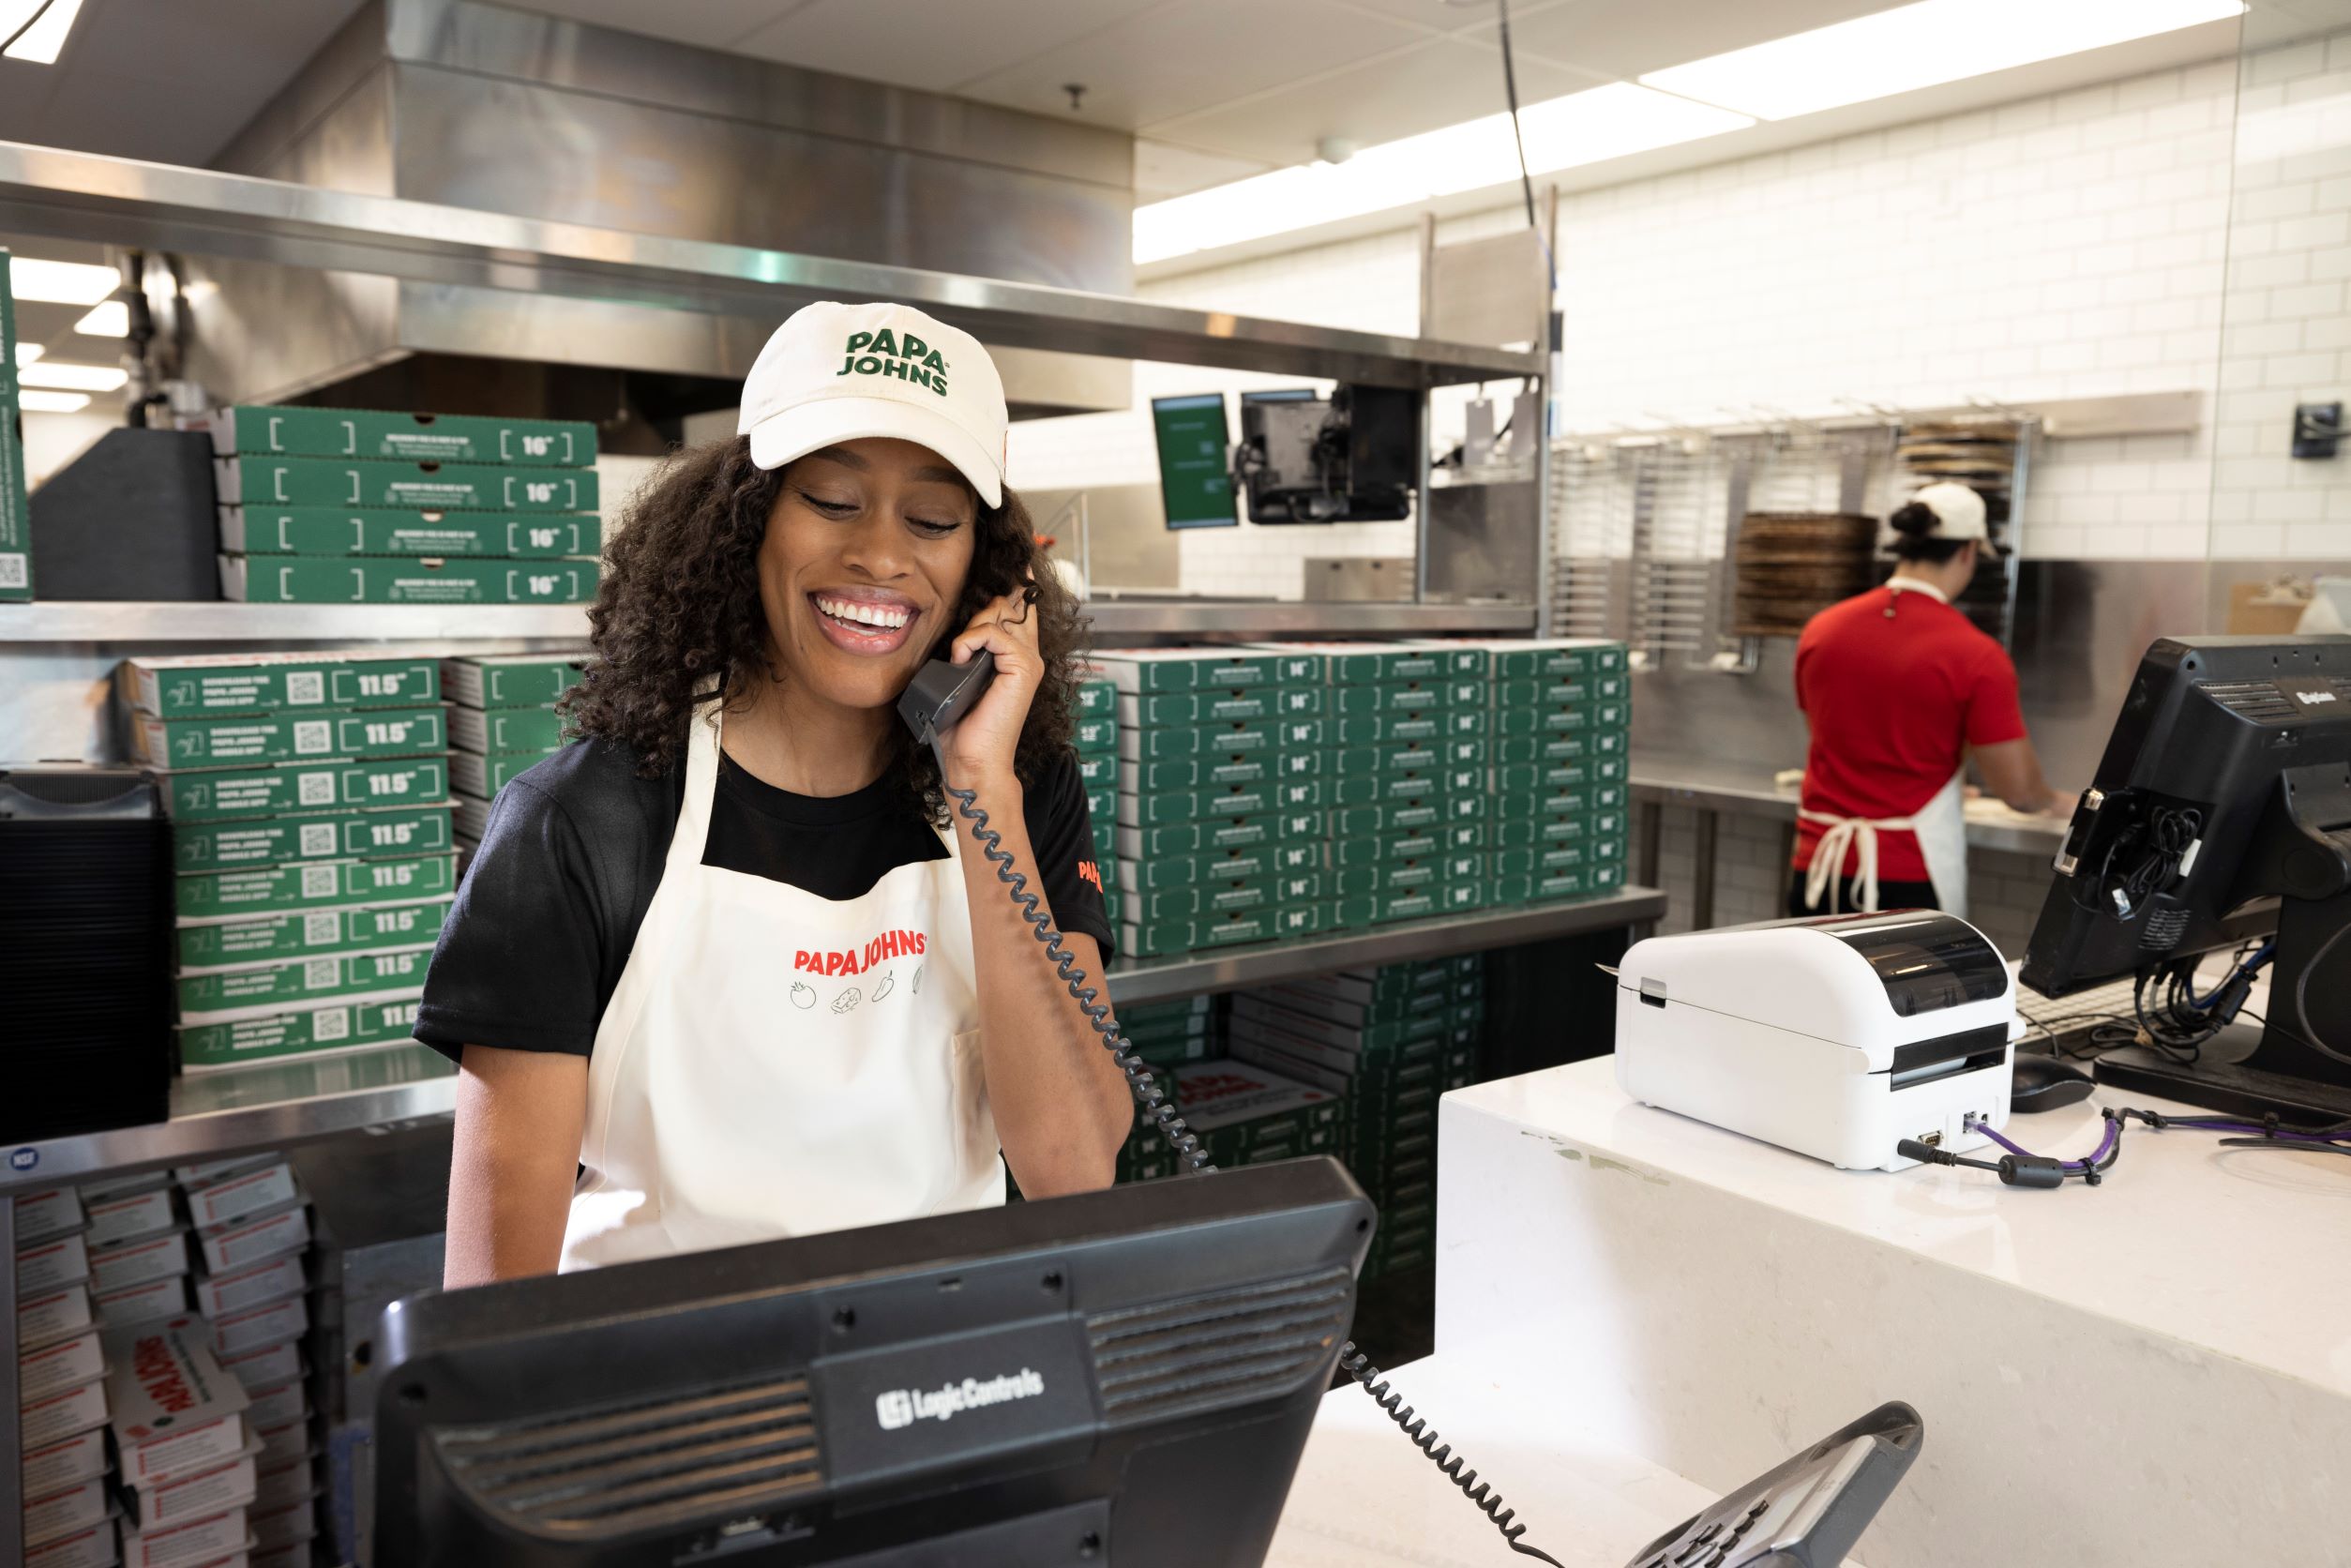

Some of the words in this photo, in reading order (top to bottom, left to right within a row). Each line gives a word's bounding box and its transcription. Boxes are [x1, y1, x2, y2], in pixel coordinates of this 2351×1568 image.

[846, 328, 947, 377] PAPA
[836, 356, 948, 397] JOHNS
[794, 950, 859, 976] PAPA
[861, 930, 925, 973] JOHNS
